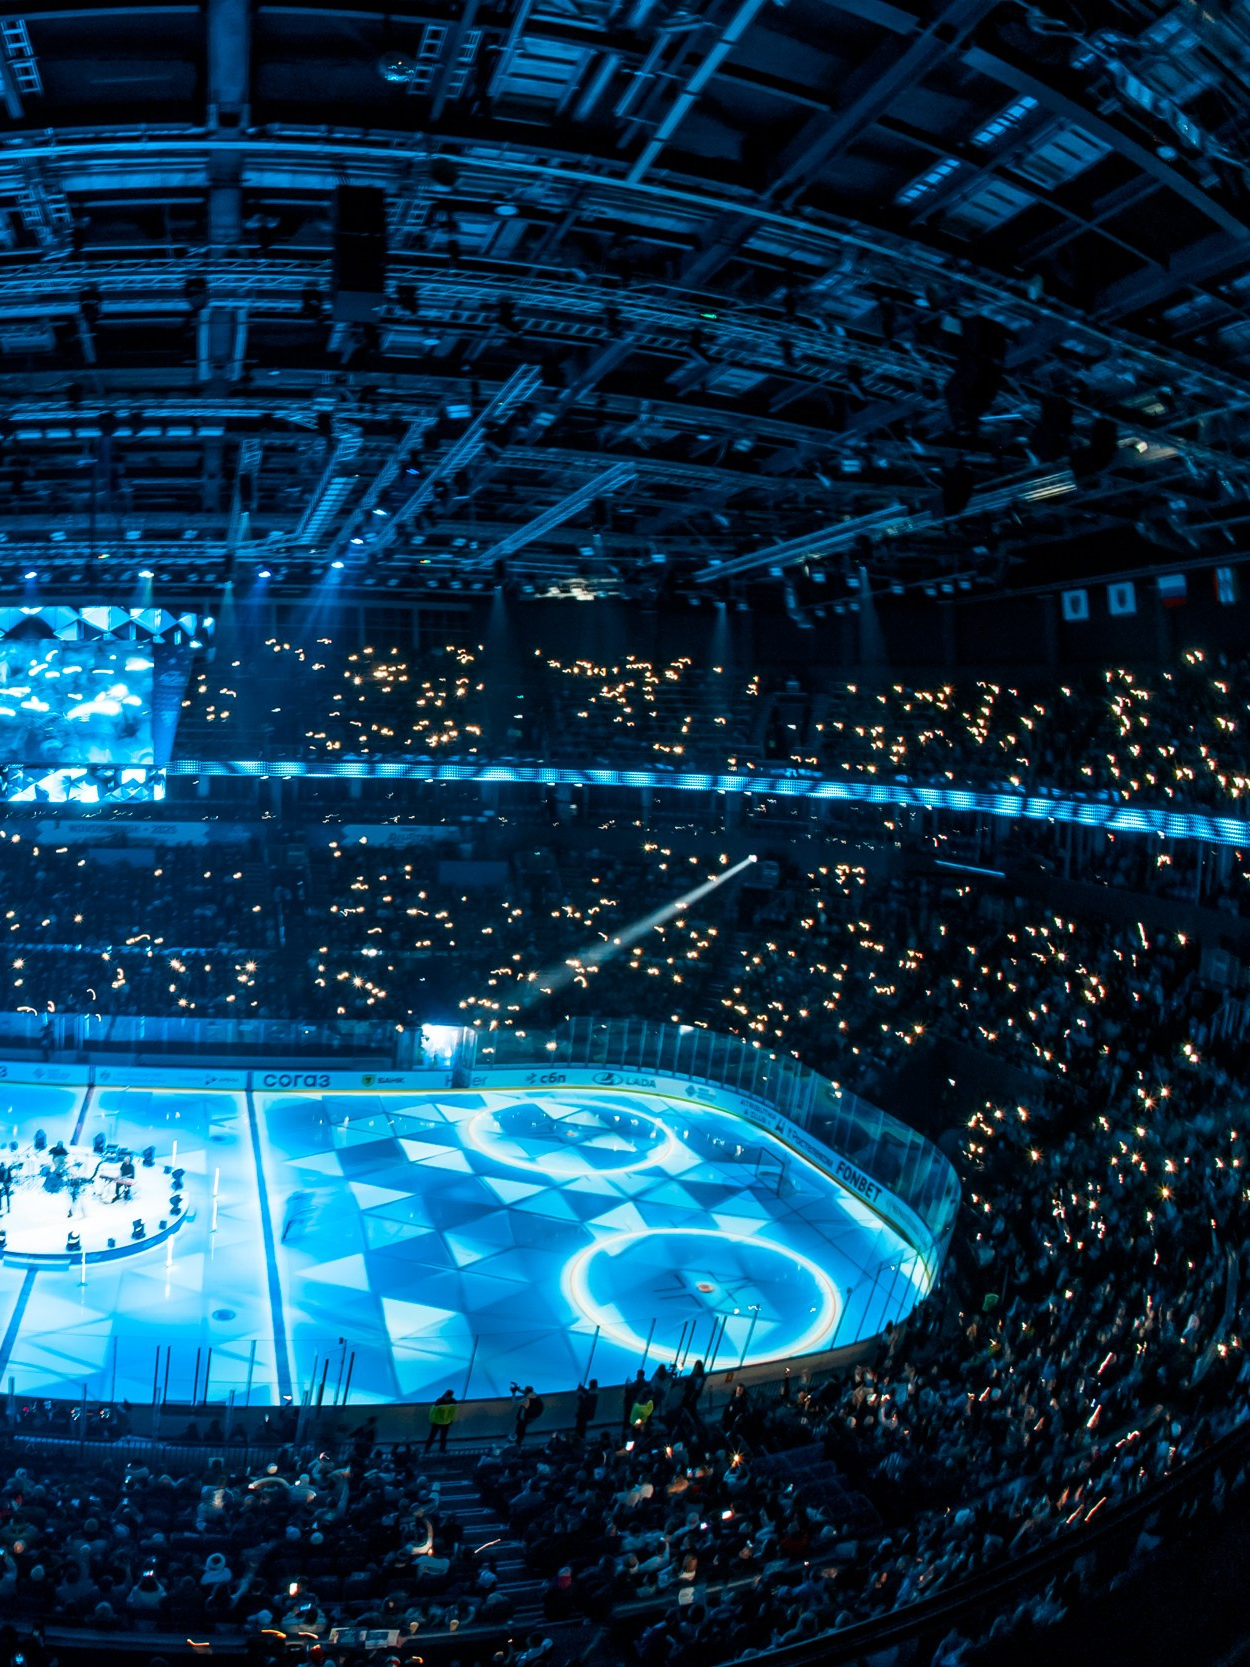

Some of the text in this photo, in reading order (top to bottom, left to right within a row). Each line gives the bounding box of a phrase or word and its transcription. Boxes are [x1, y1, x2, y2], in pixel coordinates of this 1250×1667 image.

[377, 1077, 405, 1085] БАНК
[445, 1073, 489, 1087] Her
[626, 1076, 657, 1089] LADA
[836, 1160, 884, 1203] FONBET
